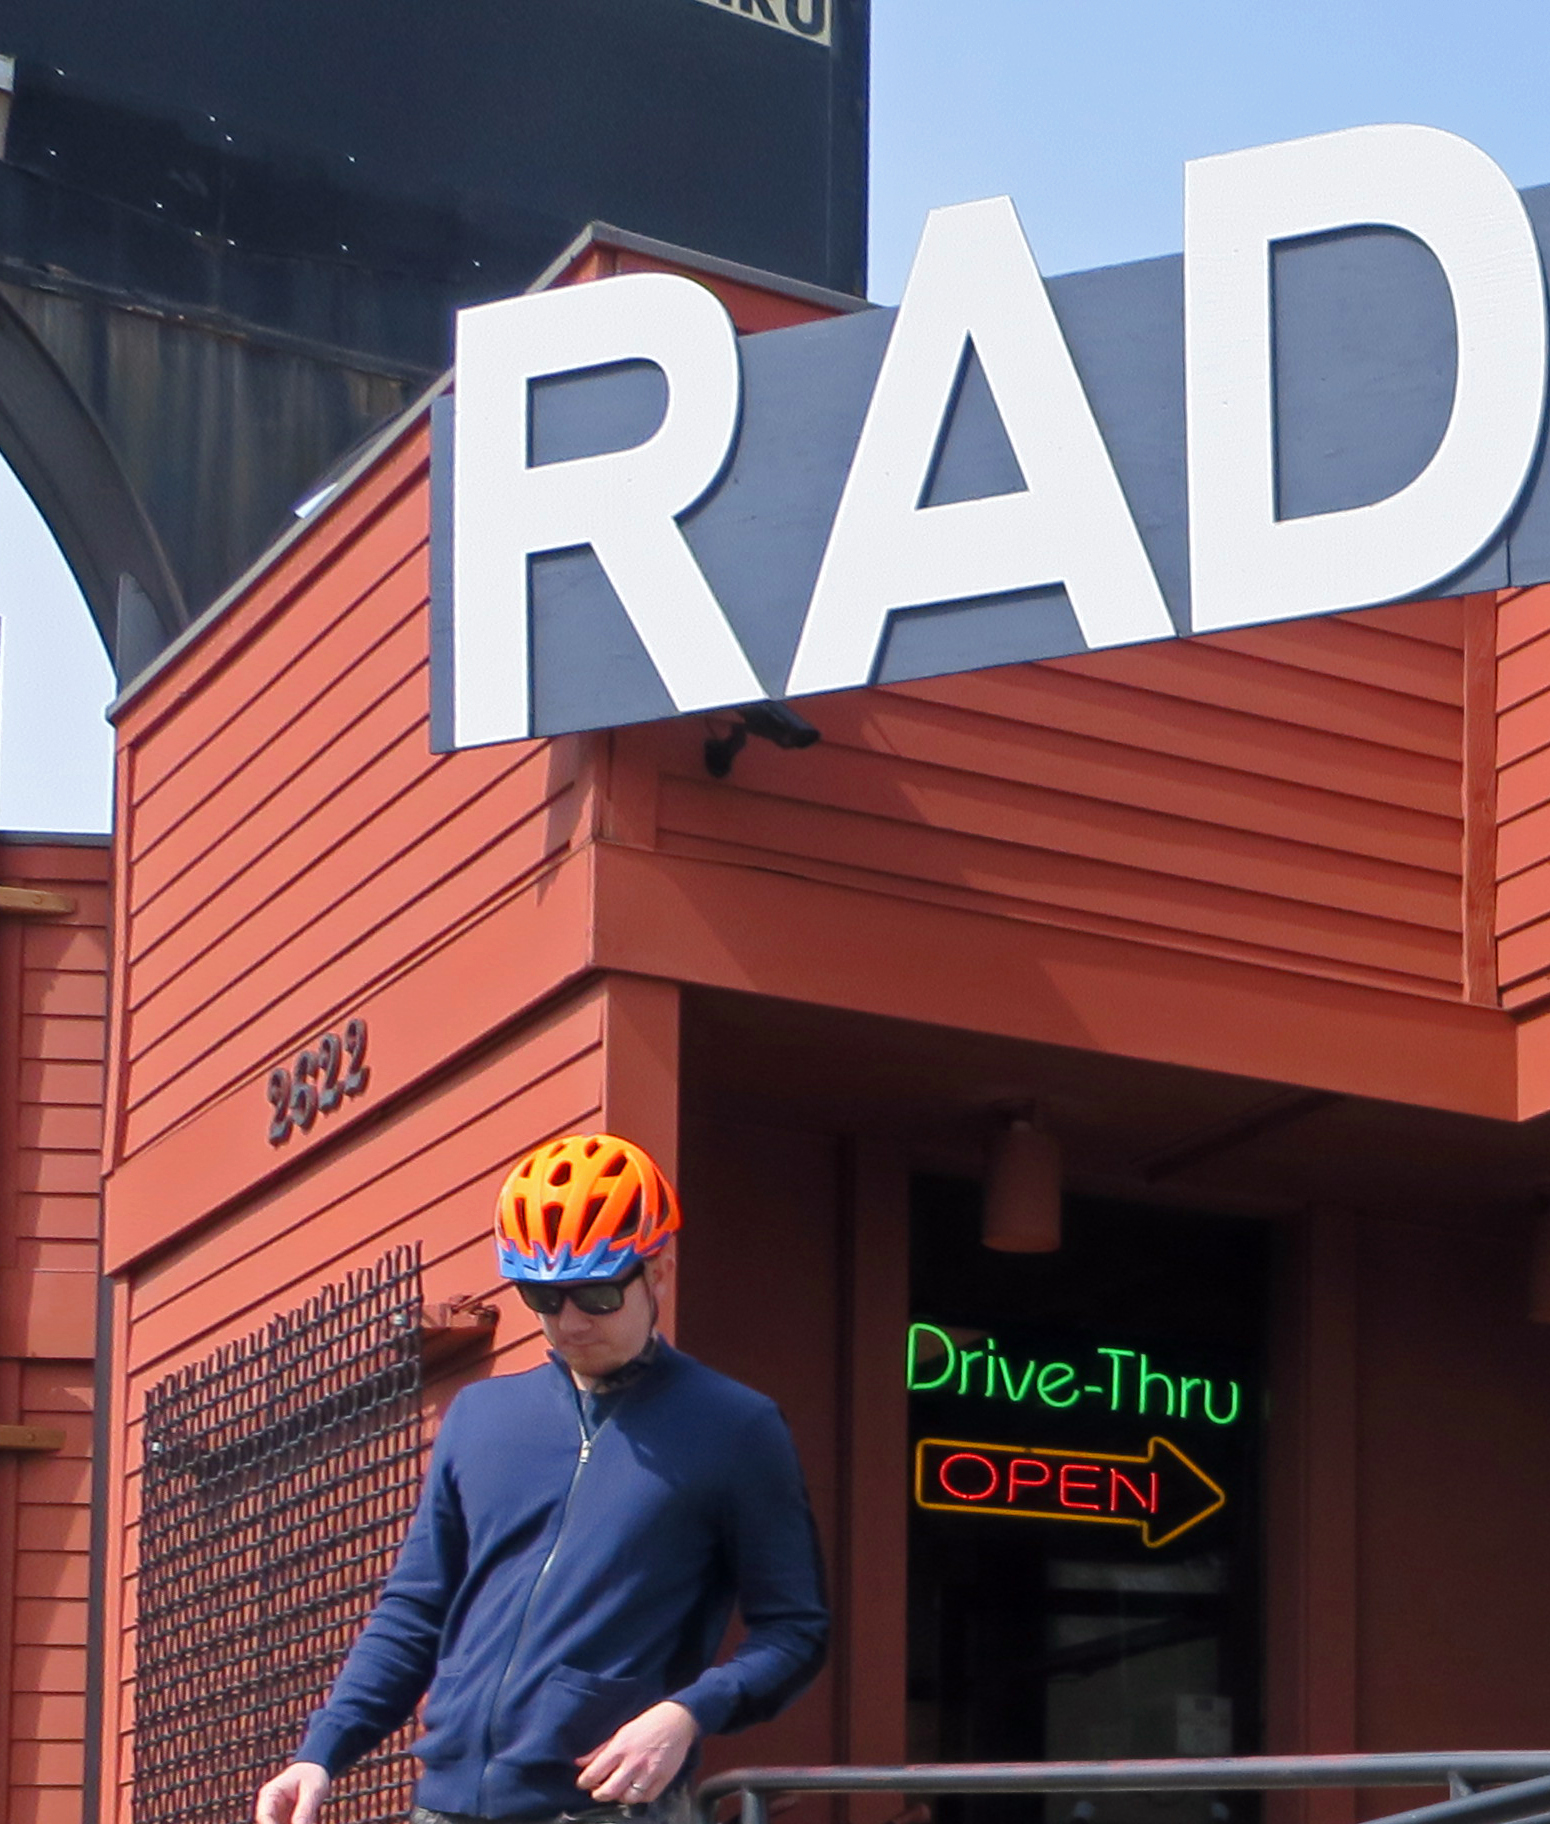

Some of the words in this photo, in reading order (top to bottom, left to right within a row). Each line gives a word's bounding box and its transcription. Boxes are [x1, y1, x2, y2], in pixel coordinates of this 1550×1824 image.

[454, 122, 1549, 749] RAD
[907, 1322, 1239, 1425] Drive-Thru
[939, 1452, 1159, 1514] OPEN
